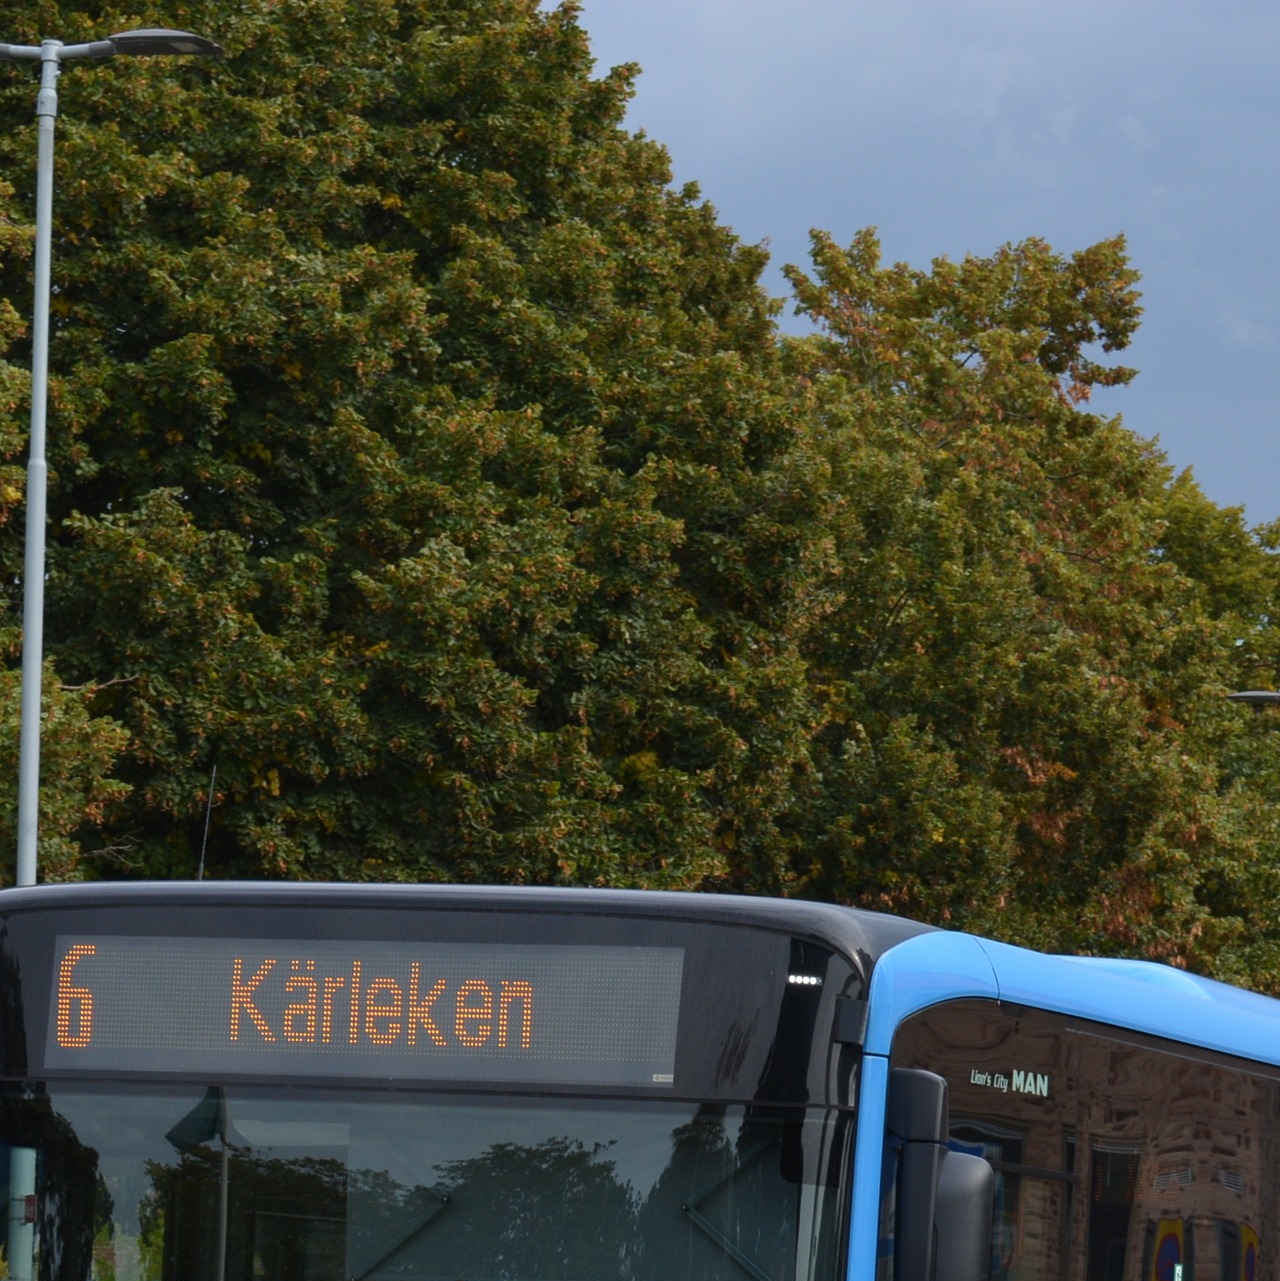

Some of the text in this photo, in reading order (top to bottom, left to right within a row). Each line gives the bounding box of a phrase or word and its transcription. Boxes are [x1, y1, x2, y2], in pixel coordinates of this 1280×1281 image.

[56, 944, 533, 1049] 6 Kärleken
[970, 1069, 1049, 1097] Lion's City MAN
